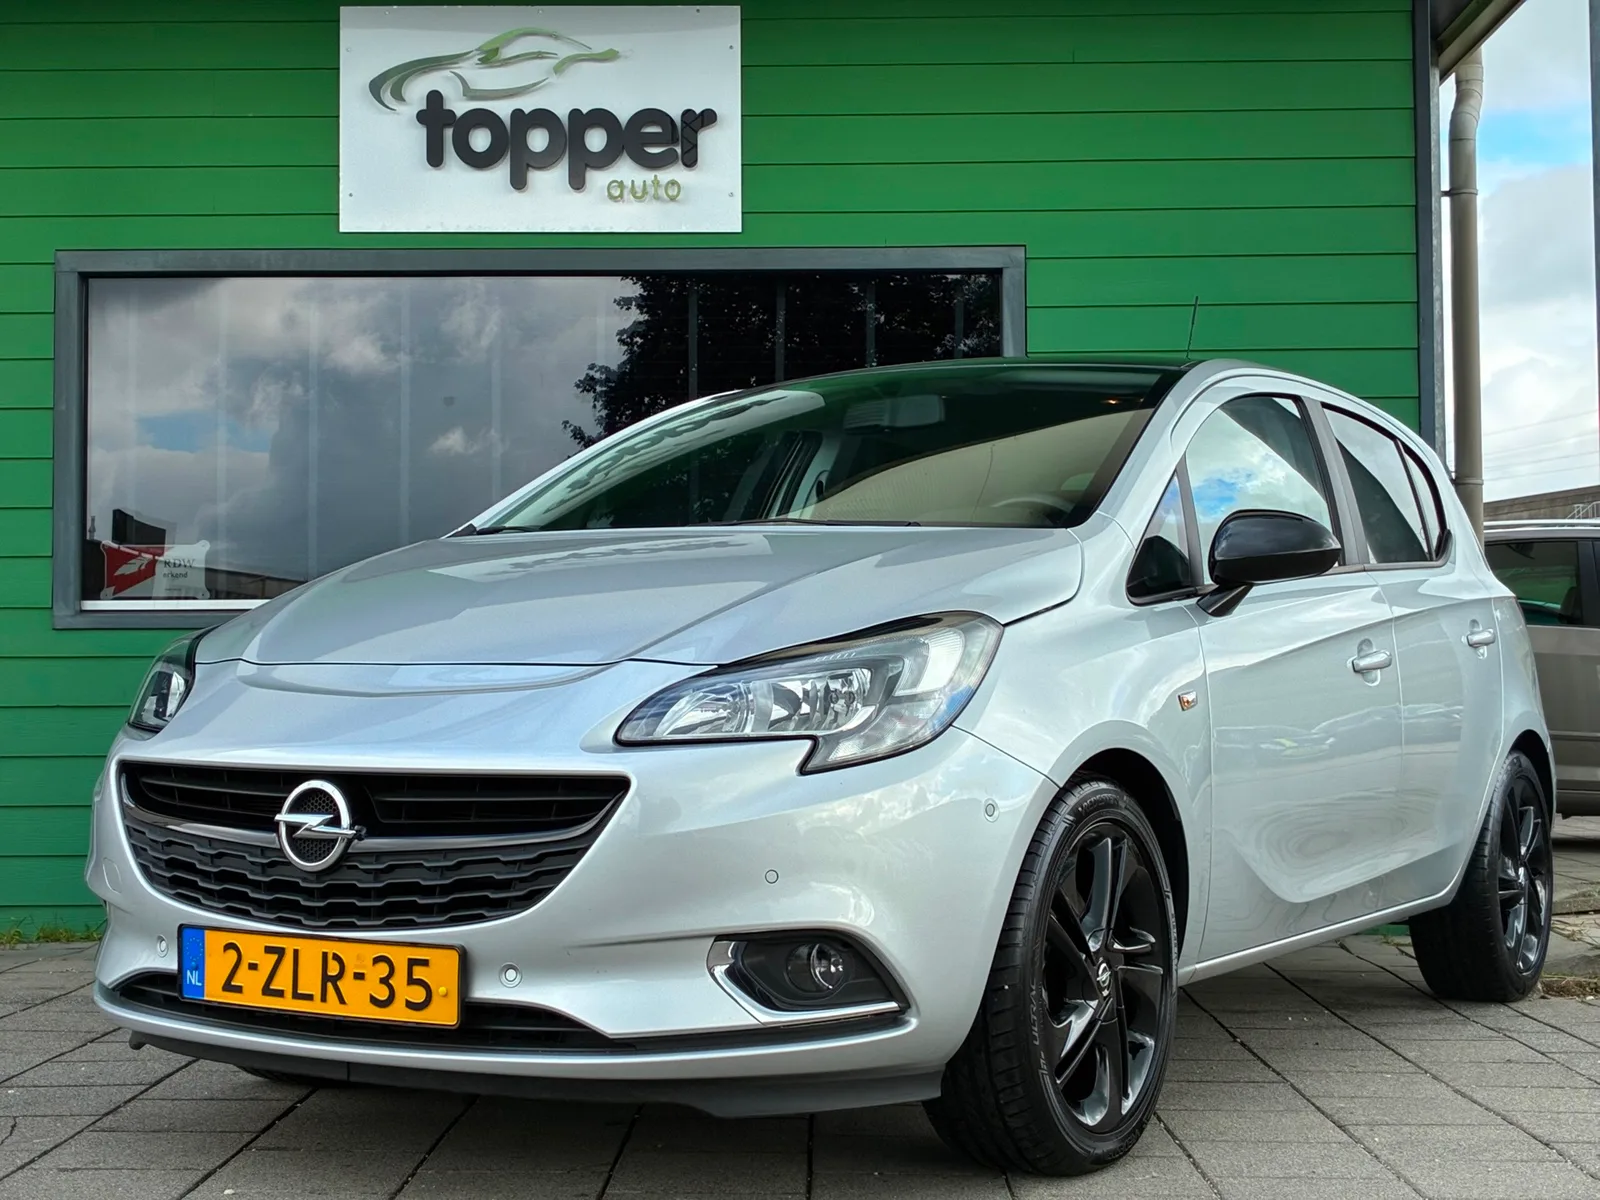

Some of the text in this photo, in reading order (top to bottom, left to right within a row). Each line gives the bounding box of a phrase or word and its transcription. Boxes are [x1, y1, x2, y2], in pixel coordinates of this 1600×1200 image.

[415, 89, 718, 191] topper
[606, 174, 682, 201] auto
[163, 558, 196, 568] RDW
[162, 571, 189, 579] erkend
[186, 969, 202, 987] NL
[221, 941, 433, 1012] 2-ZLR-35
